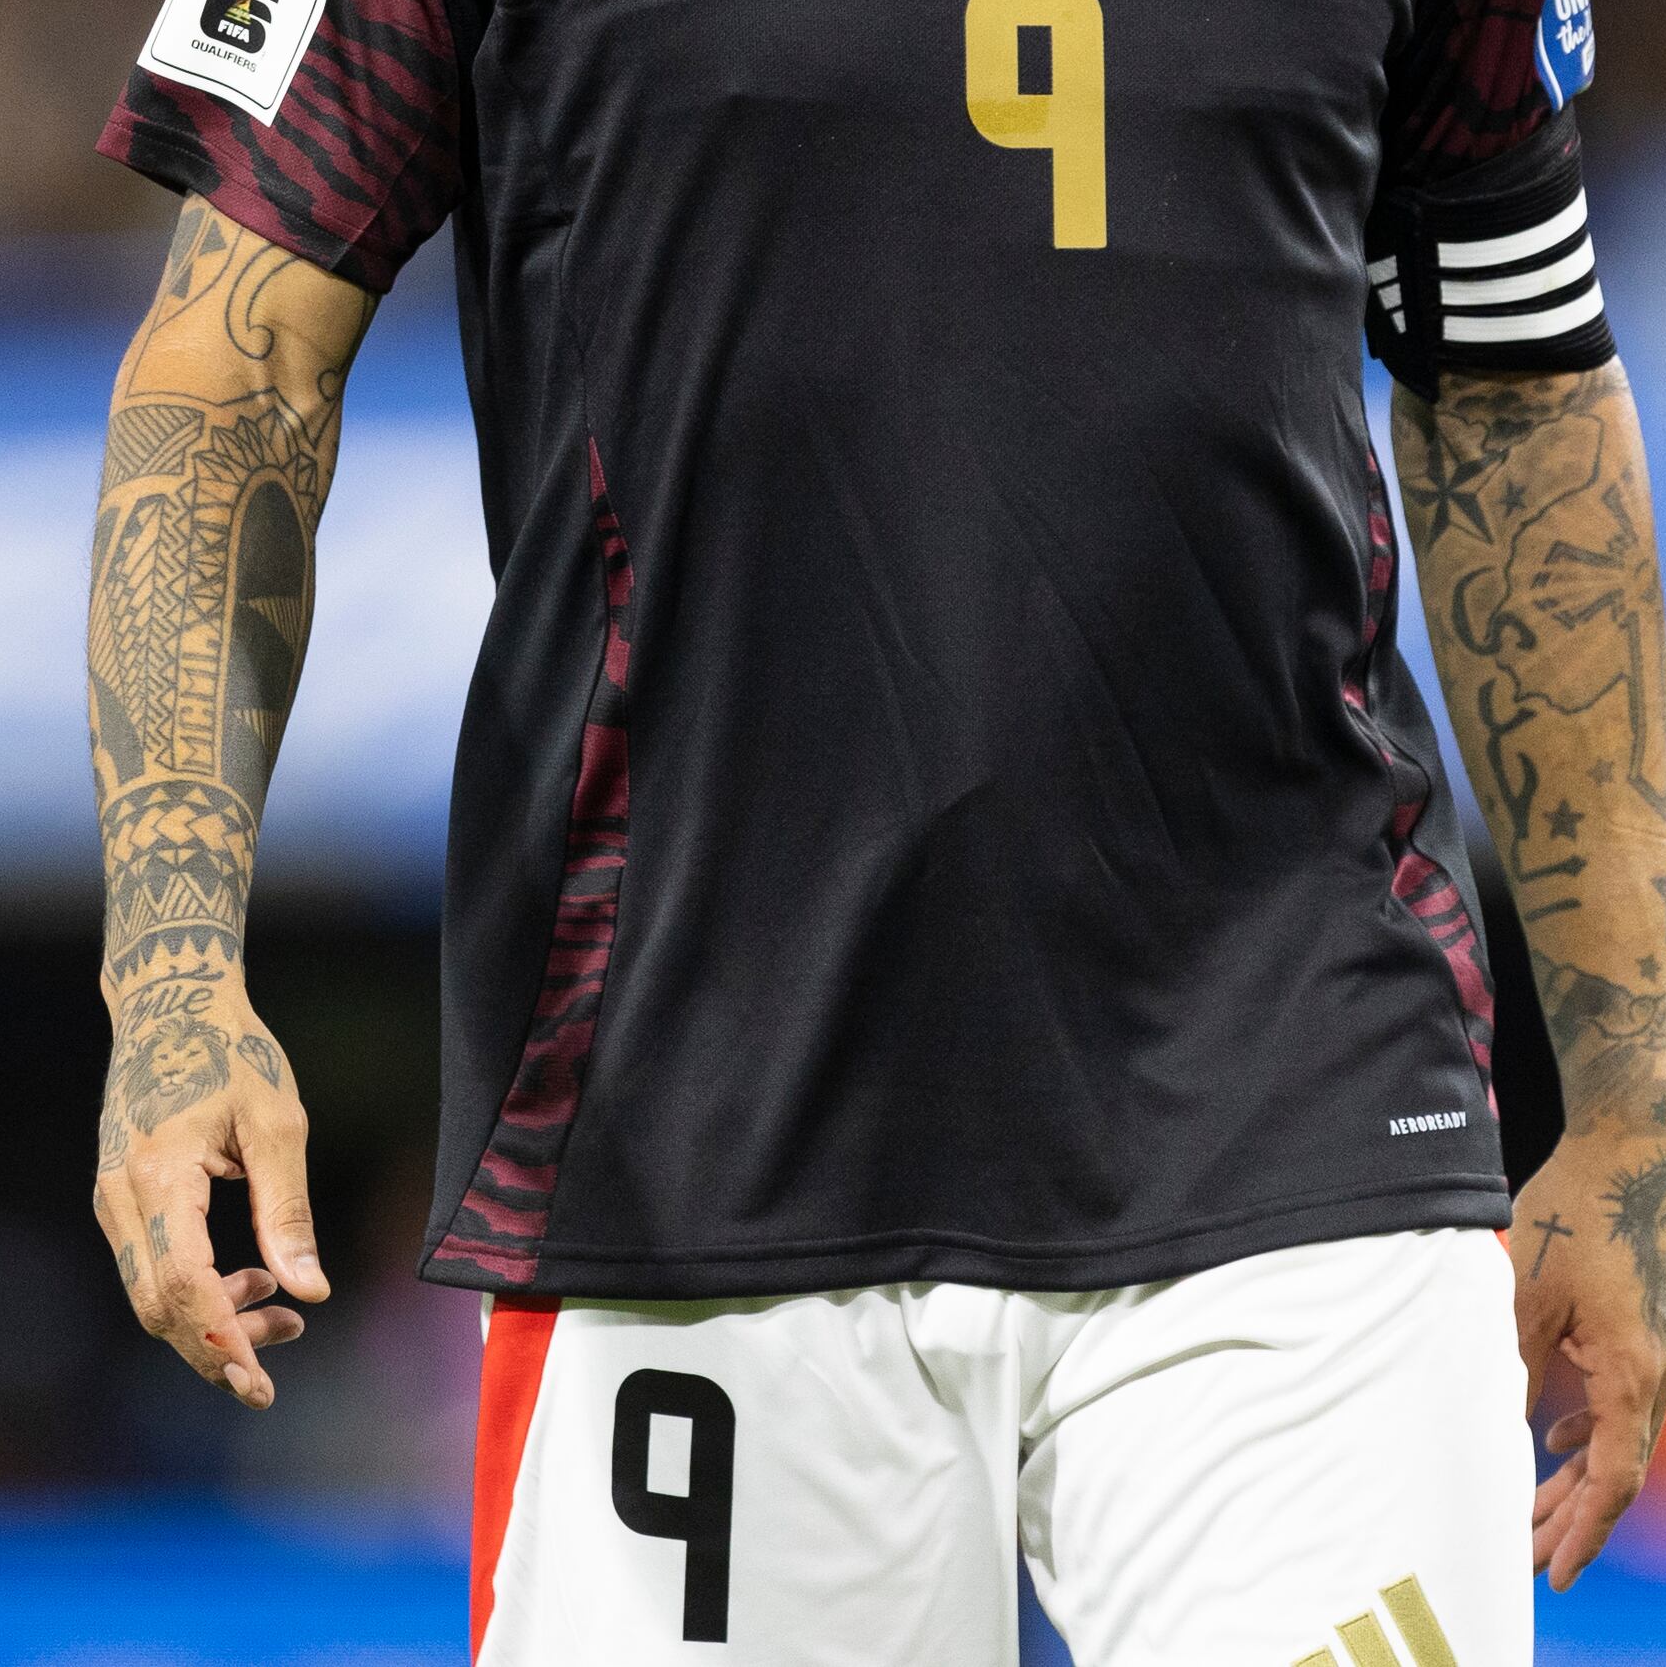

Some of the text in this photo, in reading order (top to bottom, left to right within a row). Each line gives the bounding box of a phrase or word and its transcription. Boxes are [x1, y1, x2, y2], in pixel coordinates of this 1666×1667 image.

[217, 19, 250, 43] FIFA
[191, 39, 258, 73] QUALIFIERS
[1389, 1112, 1467, 1136] AEROREADY
[611, 1368, 736, 1643] 9
